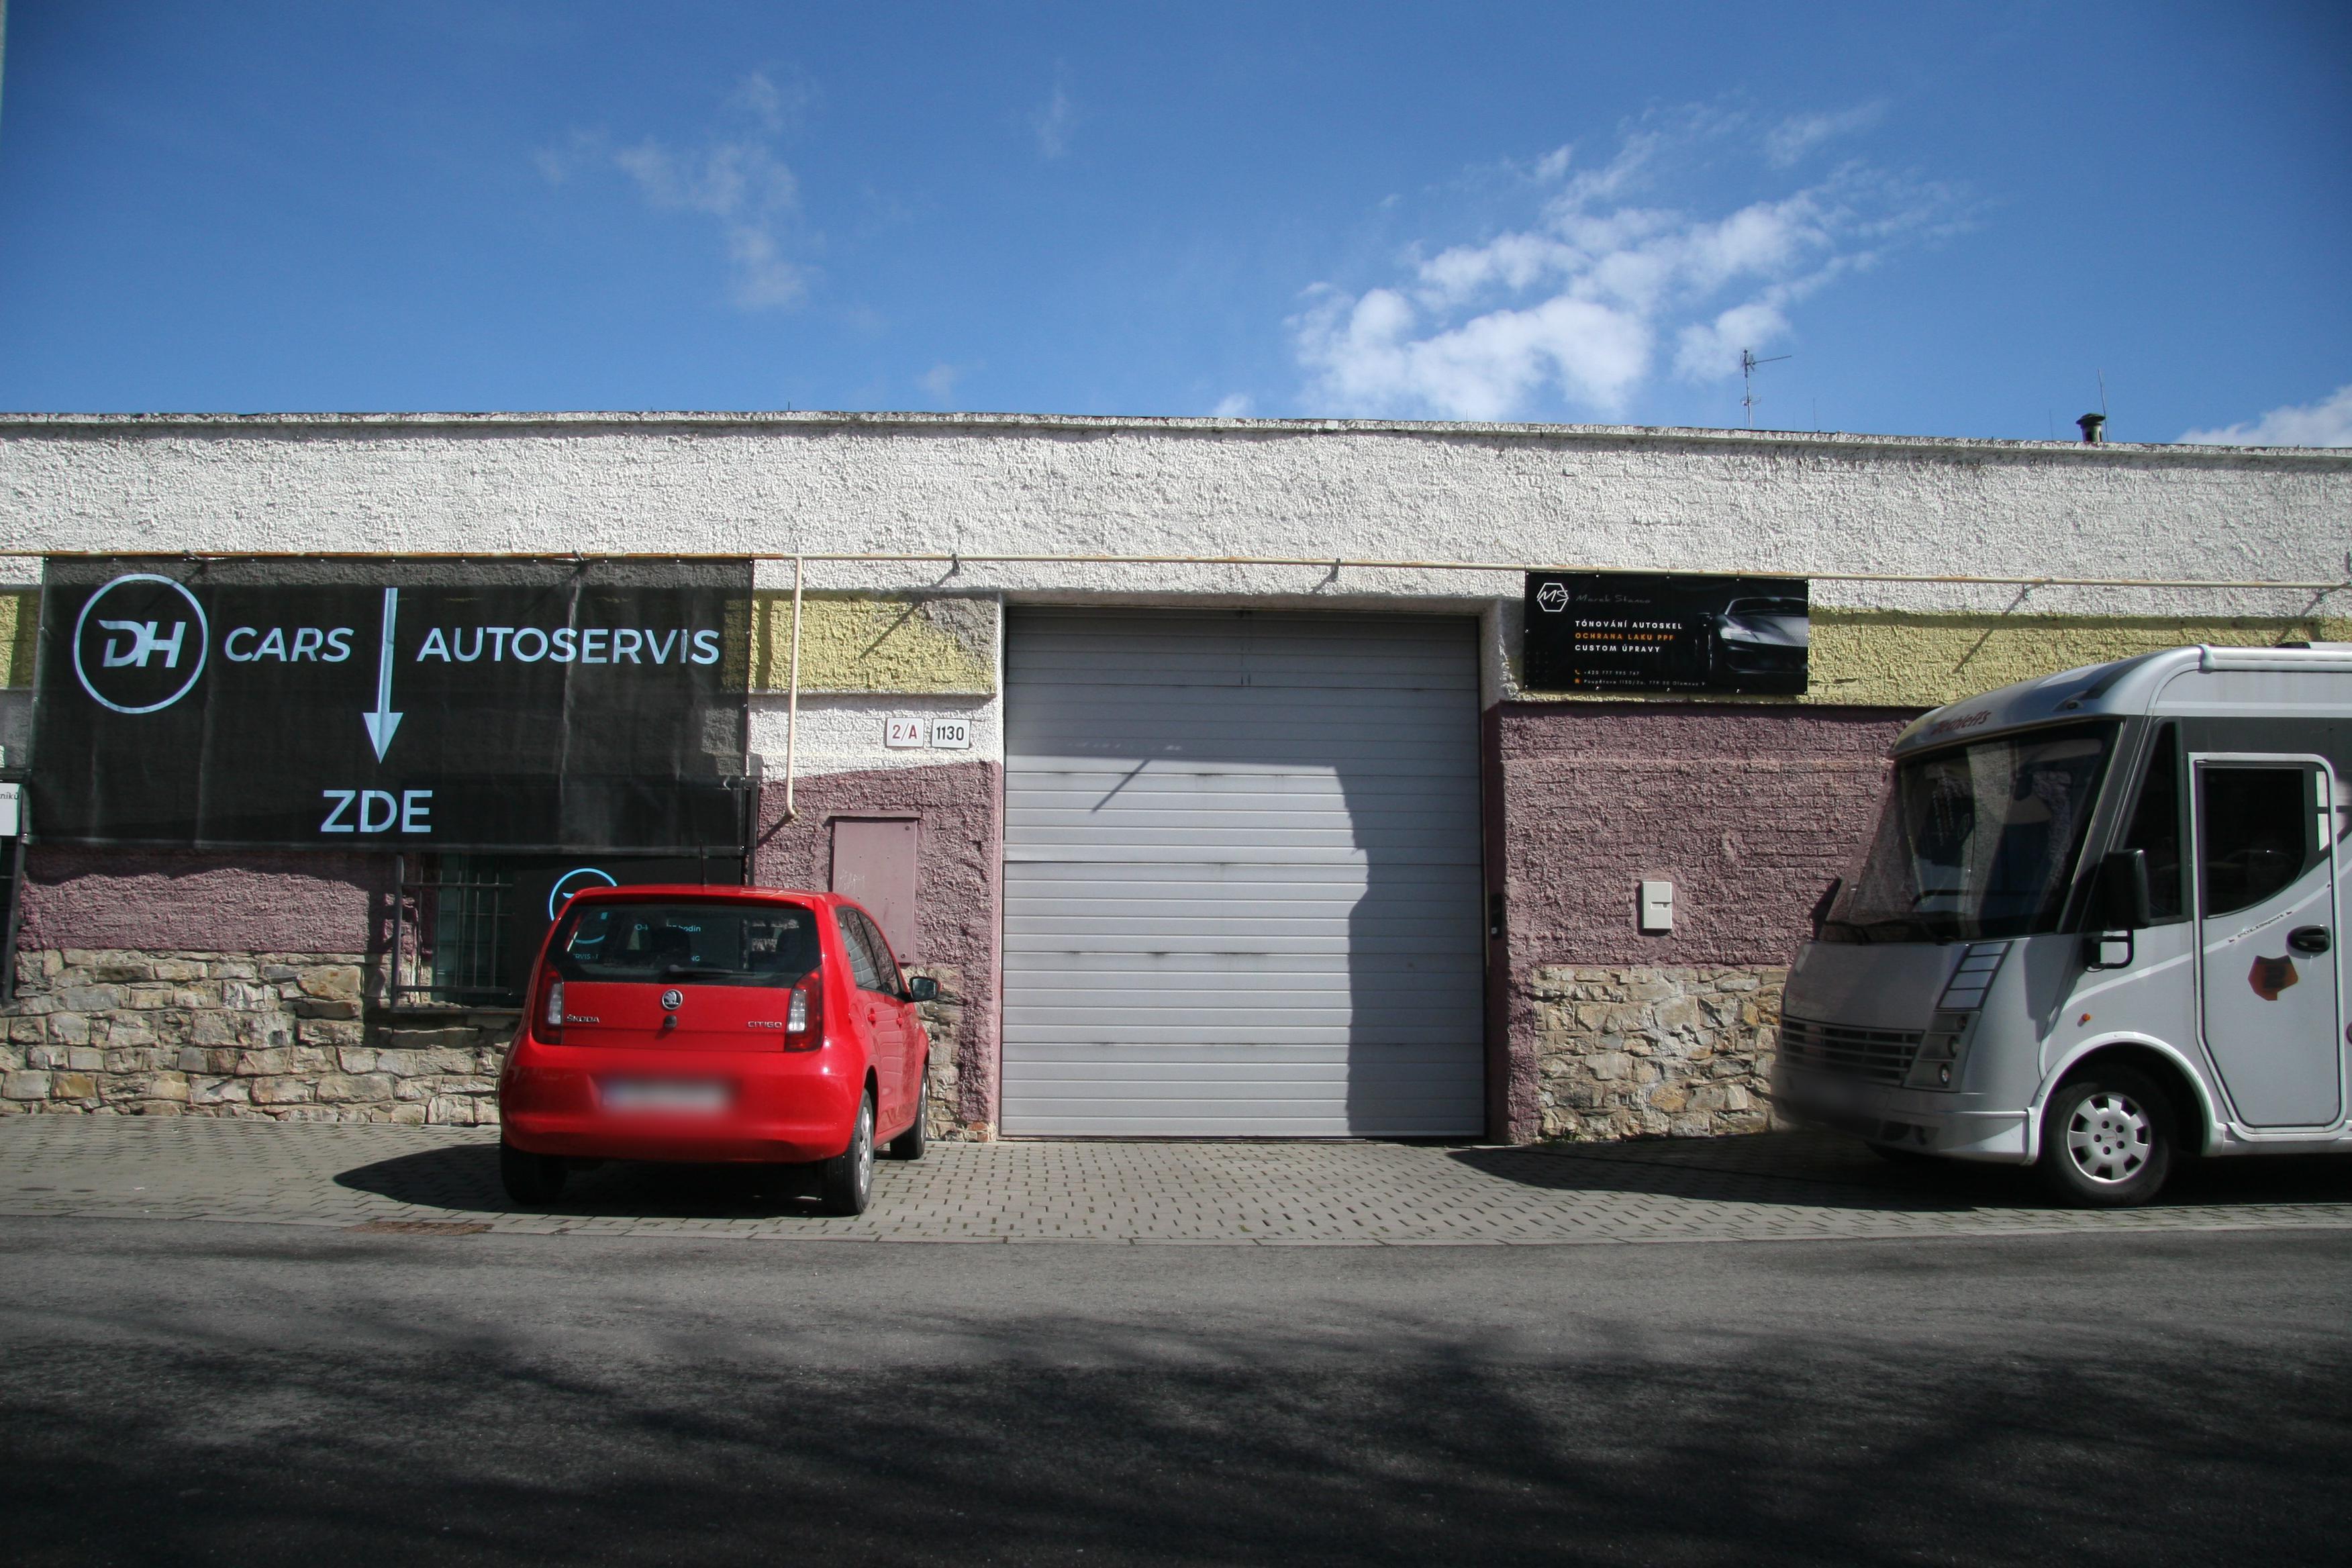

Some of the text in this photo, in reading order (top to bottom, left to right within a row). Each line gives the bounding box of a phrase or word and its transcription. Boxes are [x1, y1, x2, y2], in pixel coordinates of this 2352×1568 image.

[1575, 619, 1682, 630] TÓNOVÁNÍ AUTOSKEL
[1575, 632, 1623, 640] OCHRANA
[1627, 633, 1653, 641] LAKU
[99, 619, 720, 668] DH CARS AUTOSERVIS
[1622, 644, 1661, 652] ÚPRAVY
[892, 723, 918, 741] 2/A
[936, 726, 965, 740] 1130
[320, 789, 433, 833] ZDE
[567, 1014, 600, 1023] ŠKODA
